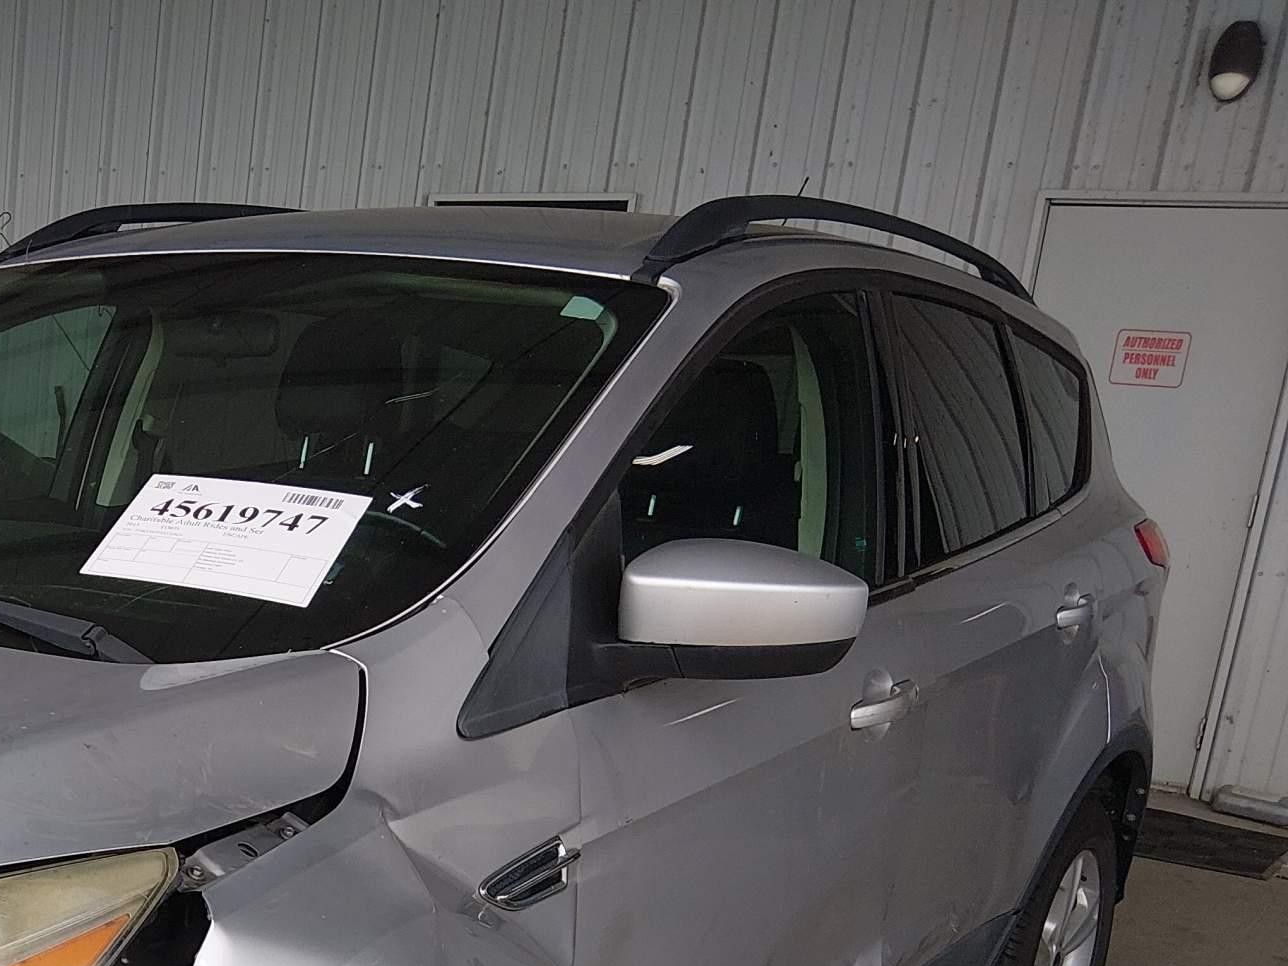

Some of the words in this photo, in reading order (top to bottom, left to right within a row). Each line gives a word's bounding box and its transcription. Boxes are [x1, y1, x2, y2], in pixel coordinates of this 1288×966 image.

[1122, 335, 1184, 350] AUTHORIZED
[1122, 352, 1176, 367] PERSONNEL
[1134, 368, 1160, 380] ONLY
[130, 514, 174, 525] Charitable
[175, 519, 202, 527] Adult
[203, 521, 229, 530] Rides
[150, 497, 329, 535] 45619747
